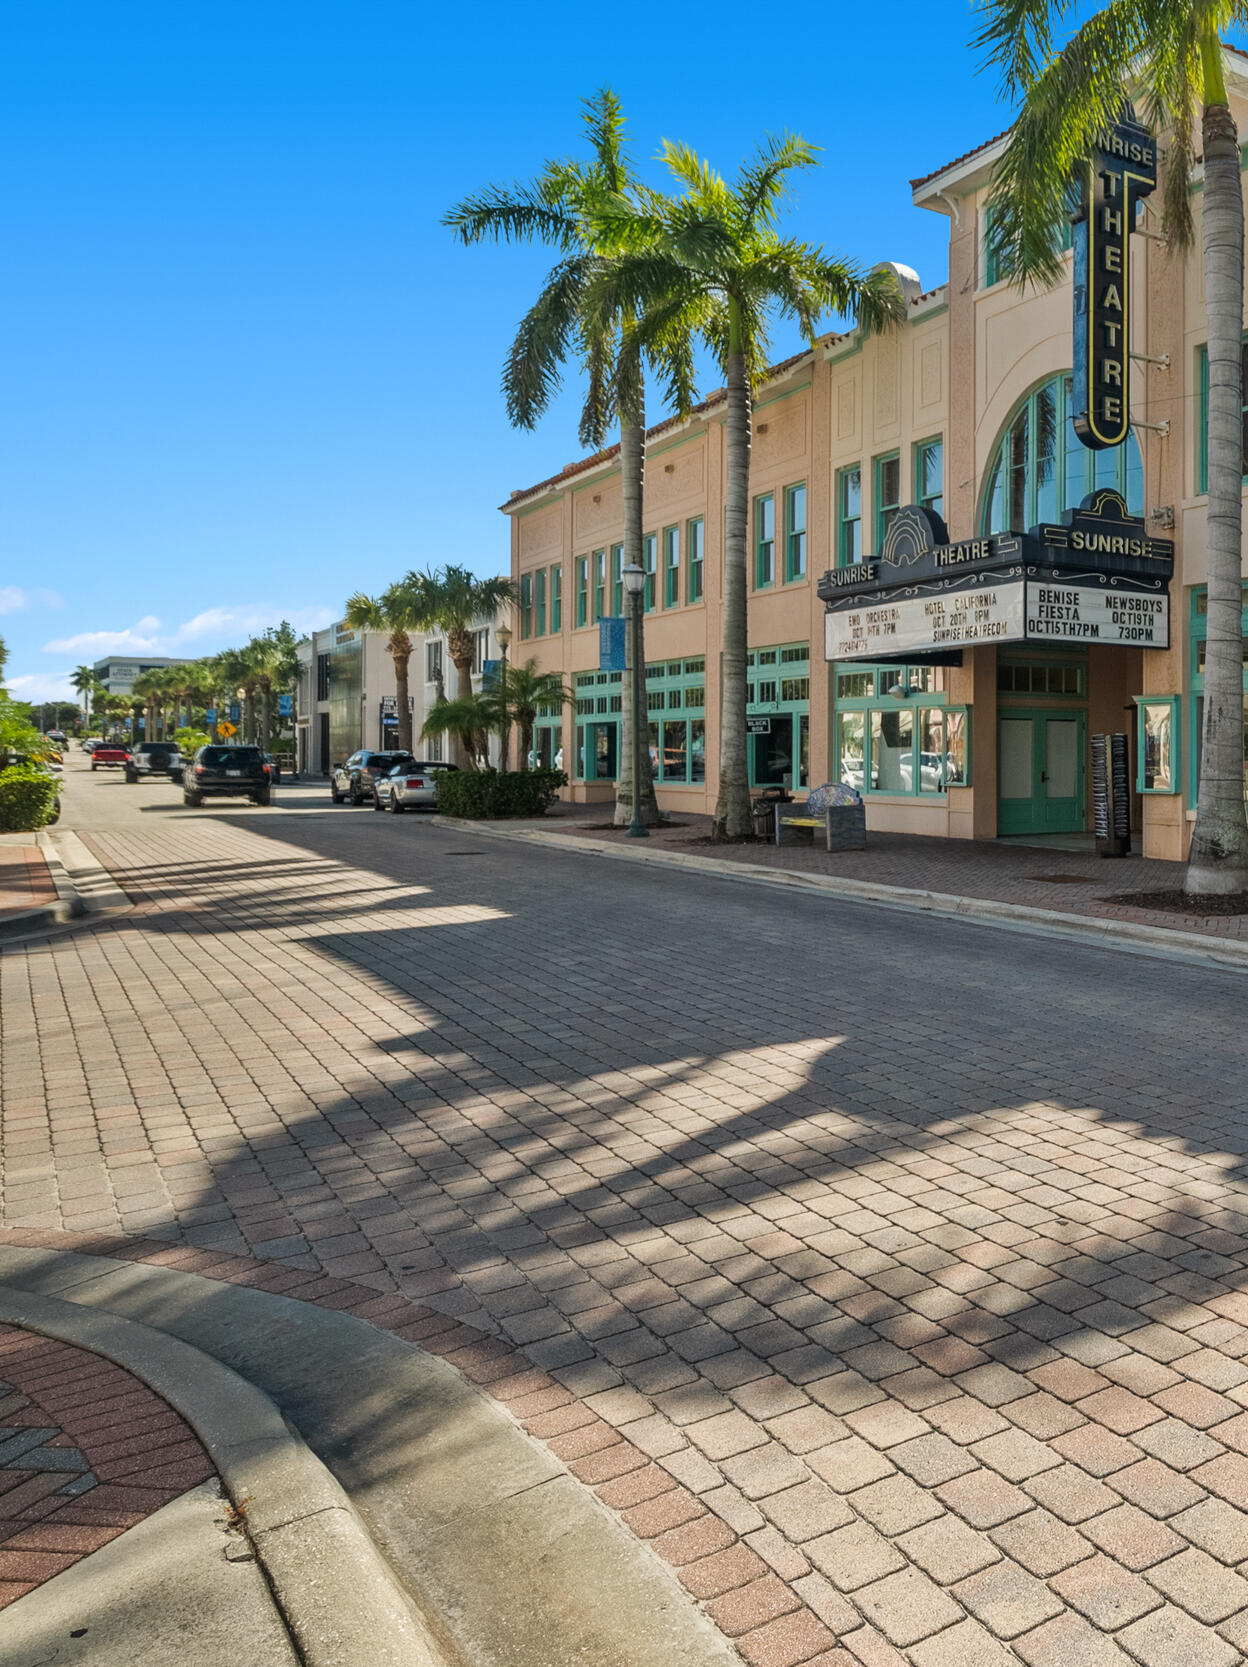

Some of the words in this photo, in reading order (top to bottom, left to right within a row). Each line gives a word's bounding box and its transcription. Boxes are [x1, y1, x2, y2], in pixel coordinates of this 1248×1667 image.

[1091, 128, 1153, 167] NRISE
[1104, 169, 1122, 424] THEATRE
[1071, 530, 1153, 558] SUNRISE
[933, 540, 990, 568] THEATRE
[830, 564, 875, 588] SUNRISE
[925, 600, 945, 616] HOTEL
[954, 592, 997, 612] CALIFORNIA
[1039, 589, 1080, 606] BENISE
[1105, 595, 1163, 613] NEWSBOYS
[933, 615, 945, 629] OCT
[950, 612, 967, 626] 20TH
[1038, 605, 1080, 621] FIESTA
[1112, 611, 1154, 626] OCT19TH
[852, 627, 863, 639] OCT
[883, 622, 896, 635] 7PM
[1118, 626, 1153, 641] 730PM
